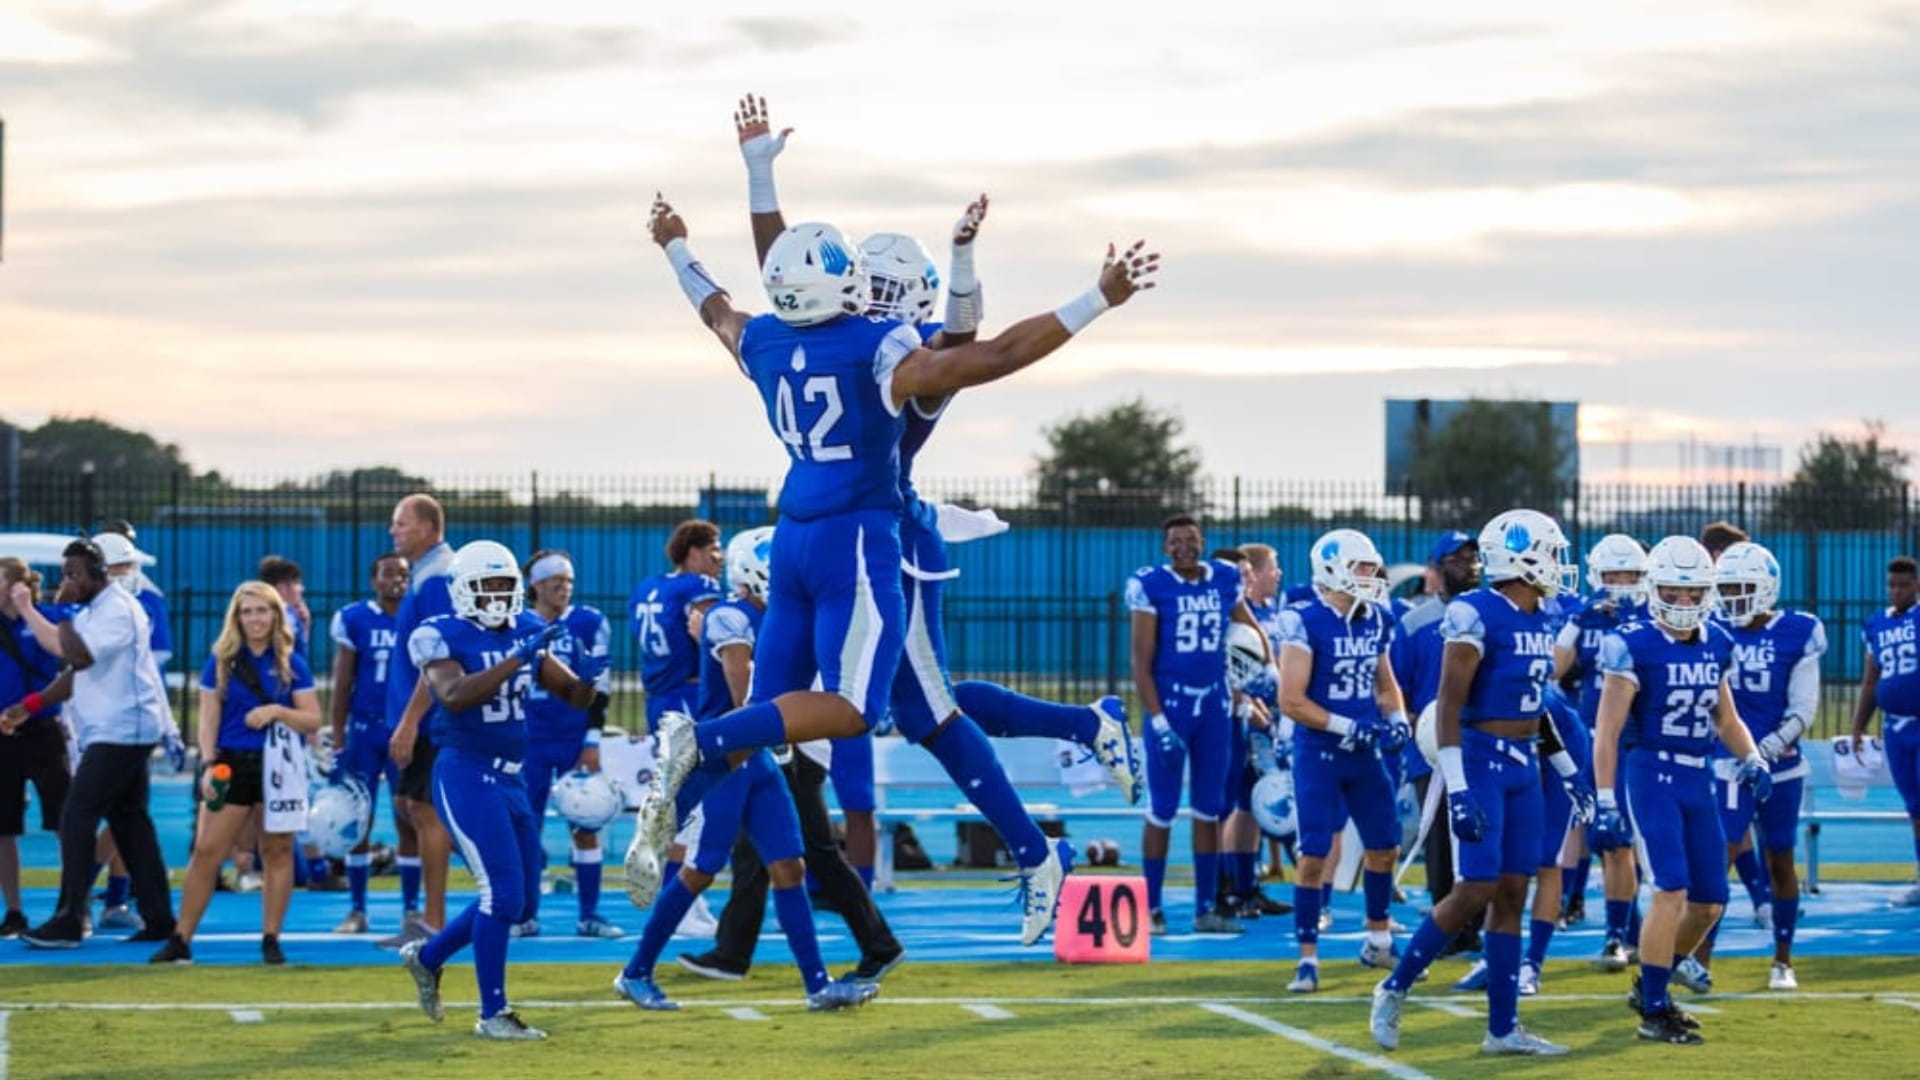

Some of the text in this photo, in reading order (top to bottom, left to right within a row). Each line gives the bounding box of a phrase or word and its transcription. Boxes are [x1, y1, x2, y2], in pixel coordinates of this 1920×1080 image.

[776, 376, 854, 461] 42
[1176, 595, 1221, 613] IMG
[636, 603, 671, 656] 75
[1176, 612, 1221, 652] 93
[1878, 624, 1916, 648] IMG
[1333, 637, 1377, 657] IMG
[1733, 643, 1776, 663] MG
[374, 650, 389, 682] 1
[1666, 662, 1720, 686] IMG
[1077, 884, 1138, 948] 40
